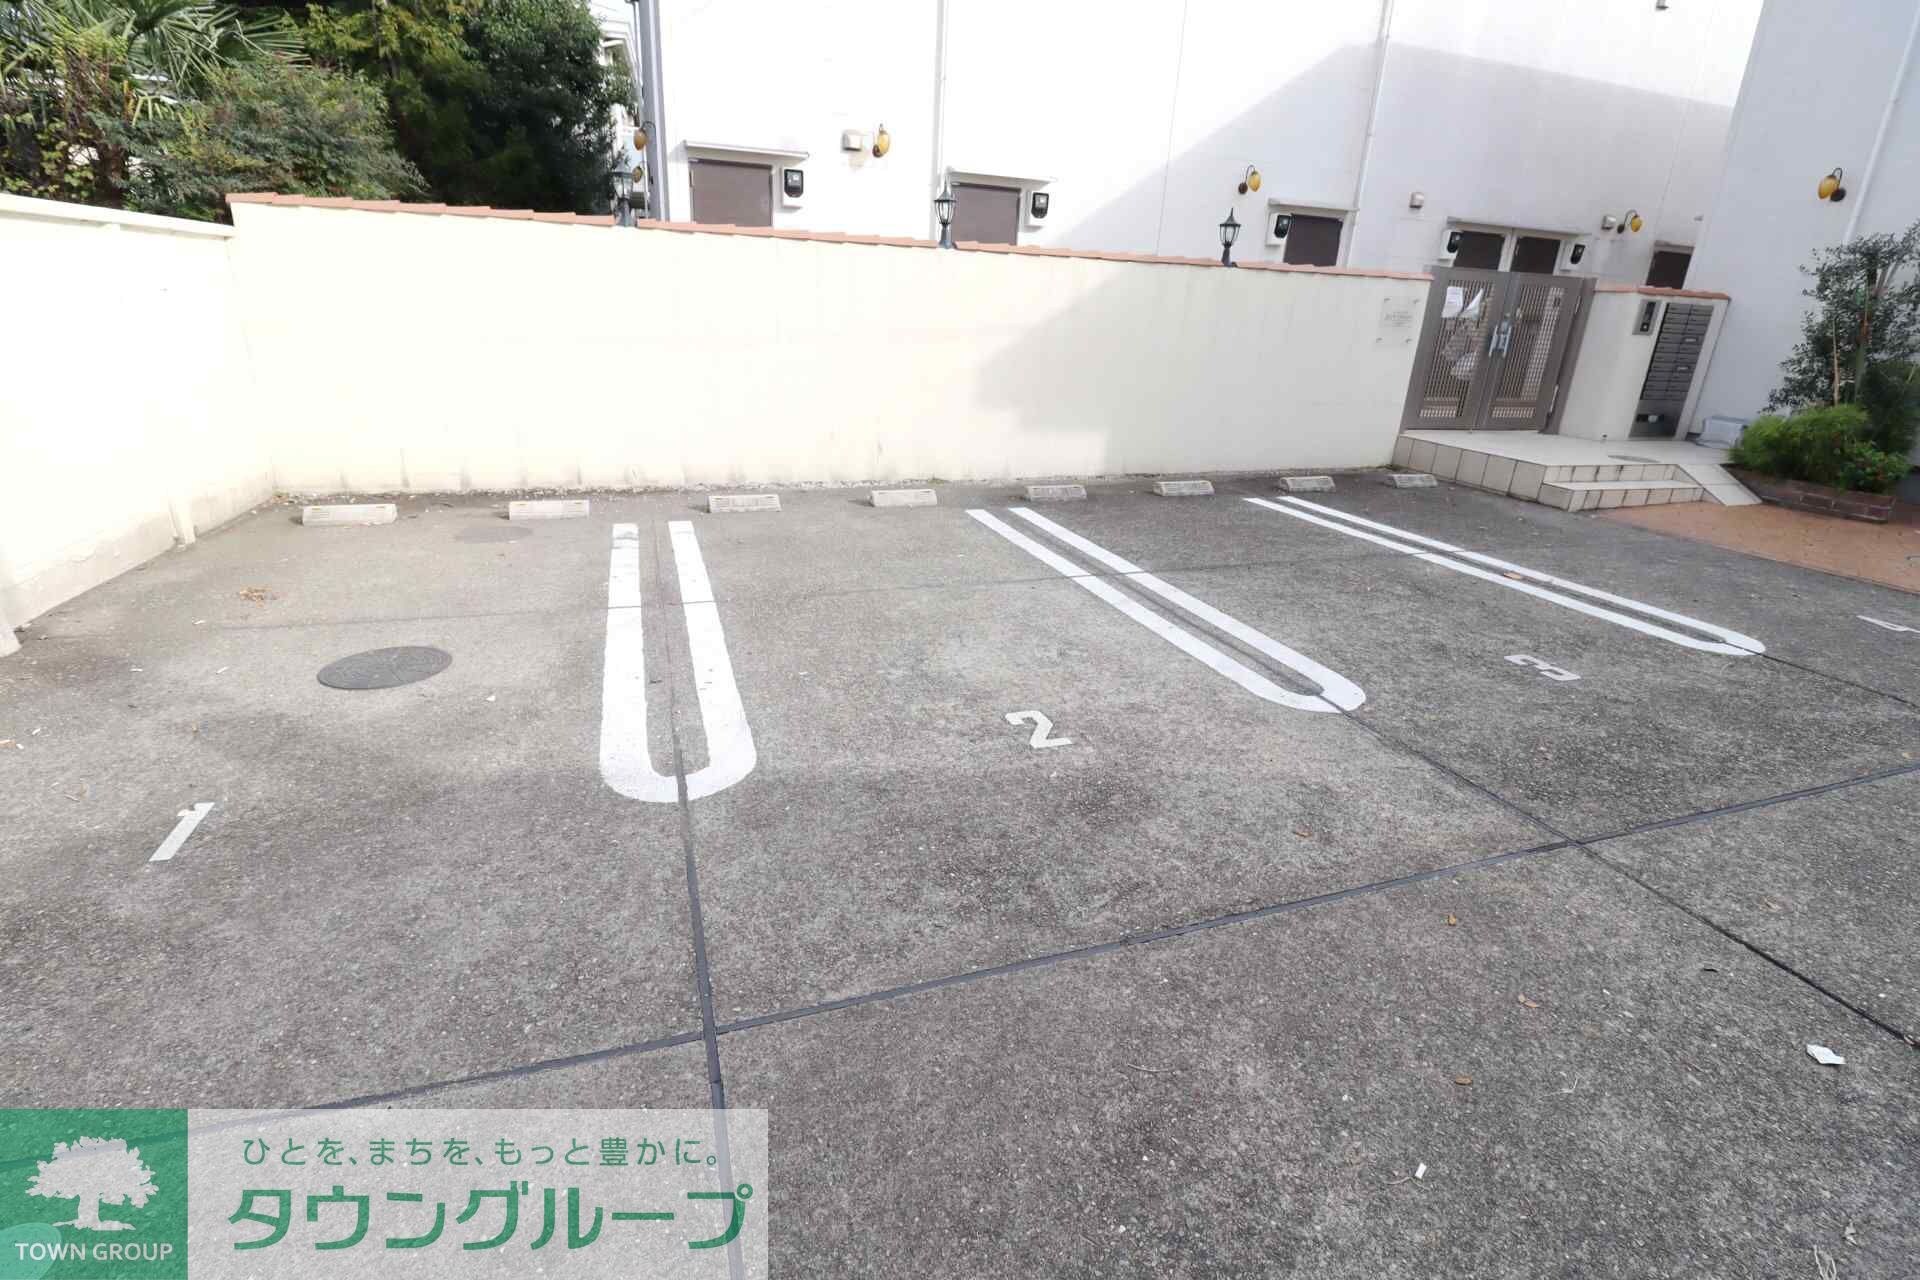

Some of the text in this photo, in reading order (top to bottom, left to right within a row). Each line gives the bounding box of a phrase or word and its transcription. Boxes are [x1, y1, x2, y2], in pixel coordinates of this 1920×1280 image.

[1503, 654, 1581, 681] 3
[1005, 710, 1073, 748] 2
[148, 802, 215, 861] 1
